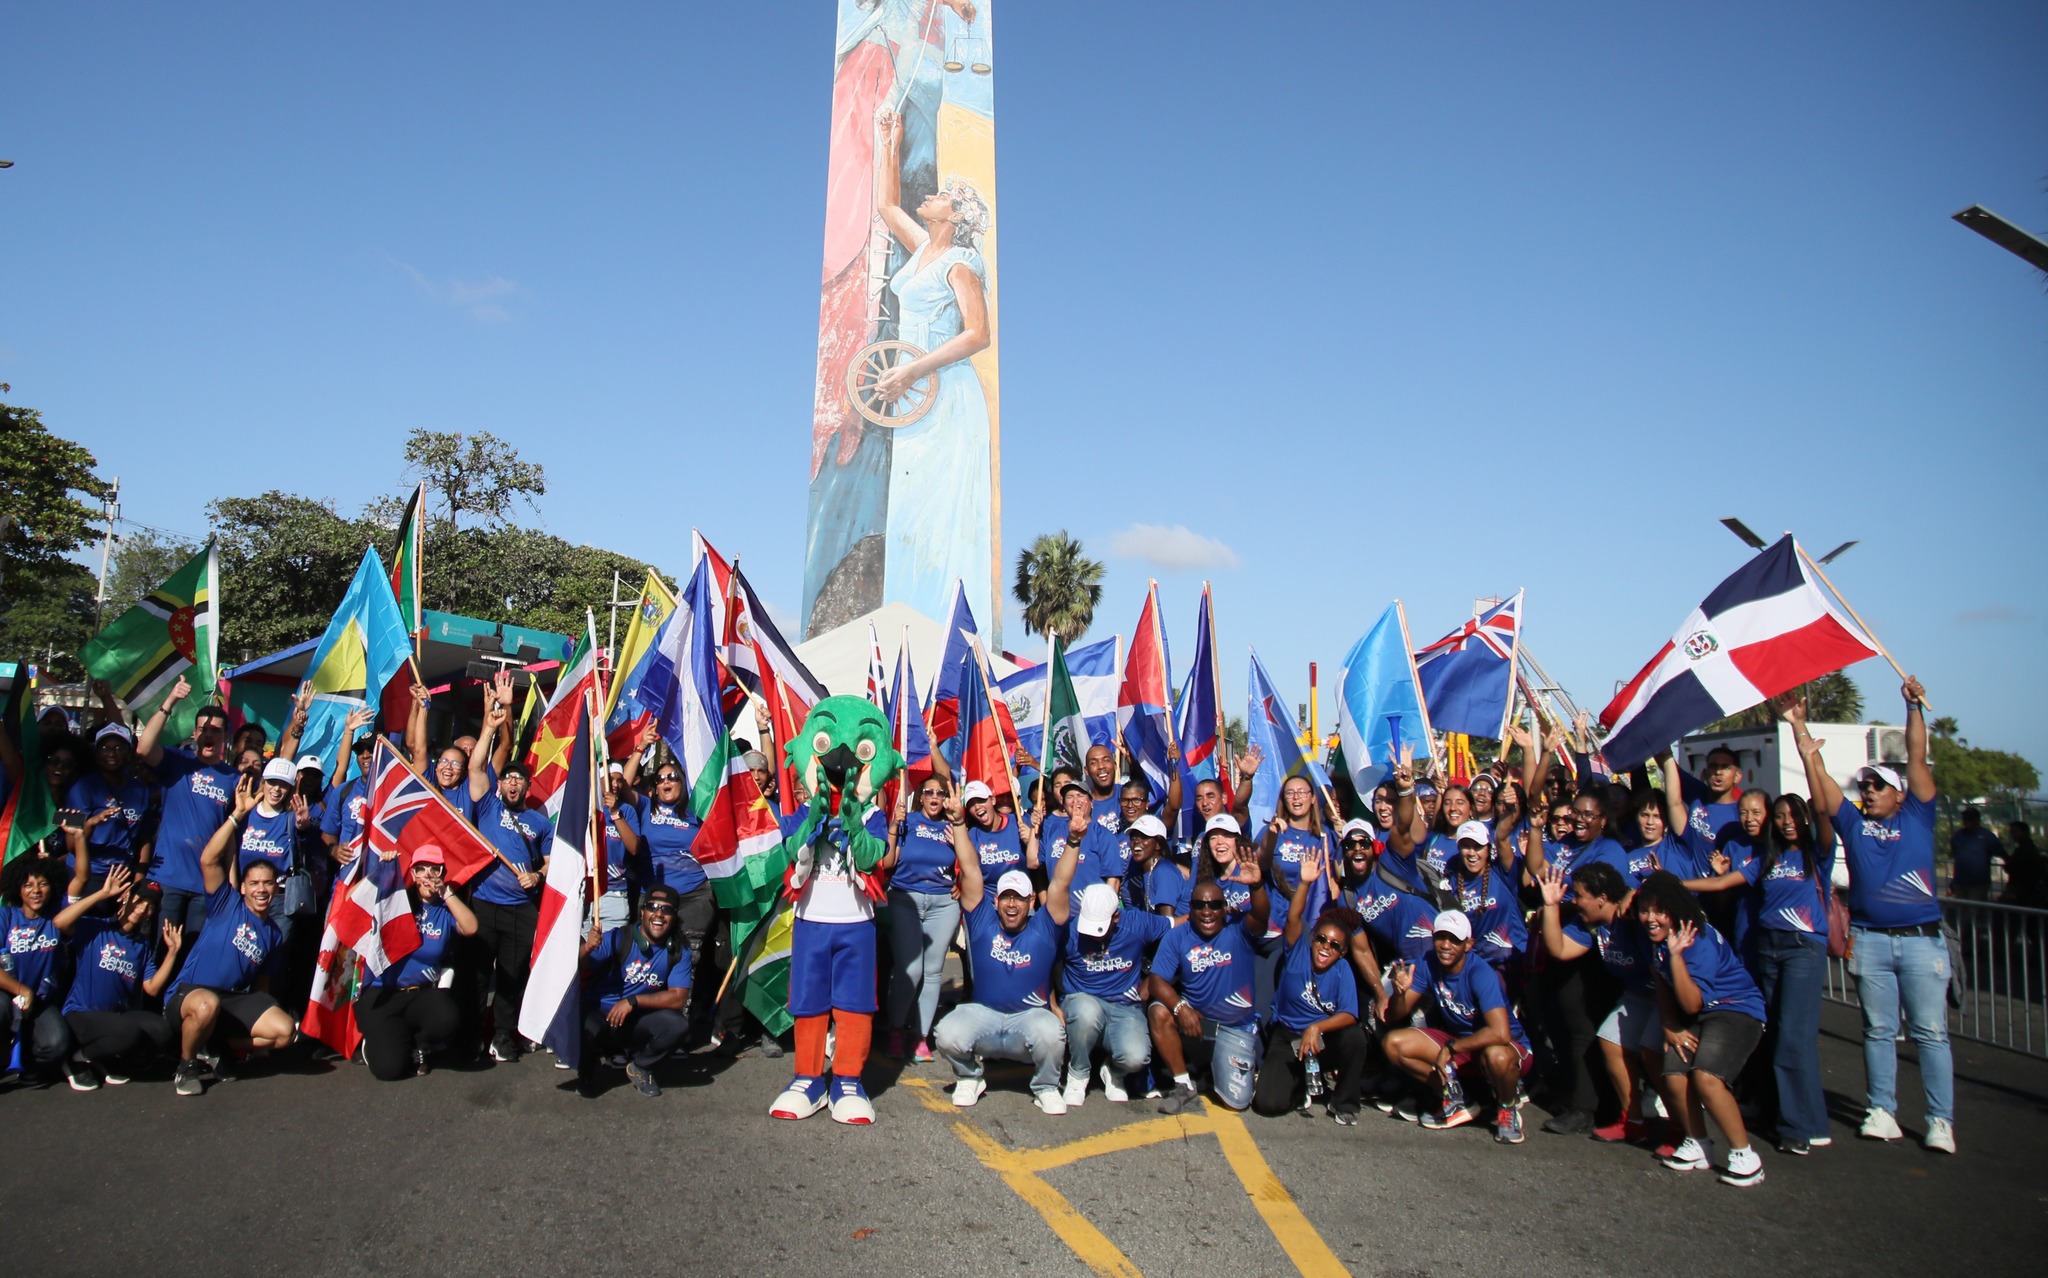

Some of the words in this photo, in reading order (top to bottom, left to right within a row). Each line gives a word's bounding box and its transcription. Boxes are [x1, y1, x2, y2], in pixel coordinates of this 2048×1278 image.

[241, 843, 284, 855] DOMINGO
[242, 838, 275, 848] SANTO
[980, 853, 1020, 865] DOMINGO
[981, 849, 1010, 860] SANTO
[102, 955, 133, 970] SANTO
[1086, 960, 1133, 973] DOMINGO
[1087, 957, 1122, 967] SANTO
[99, 960, 138, 979] DOMINGO
